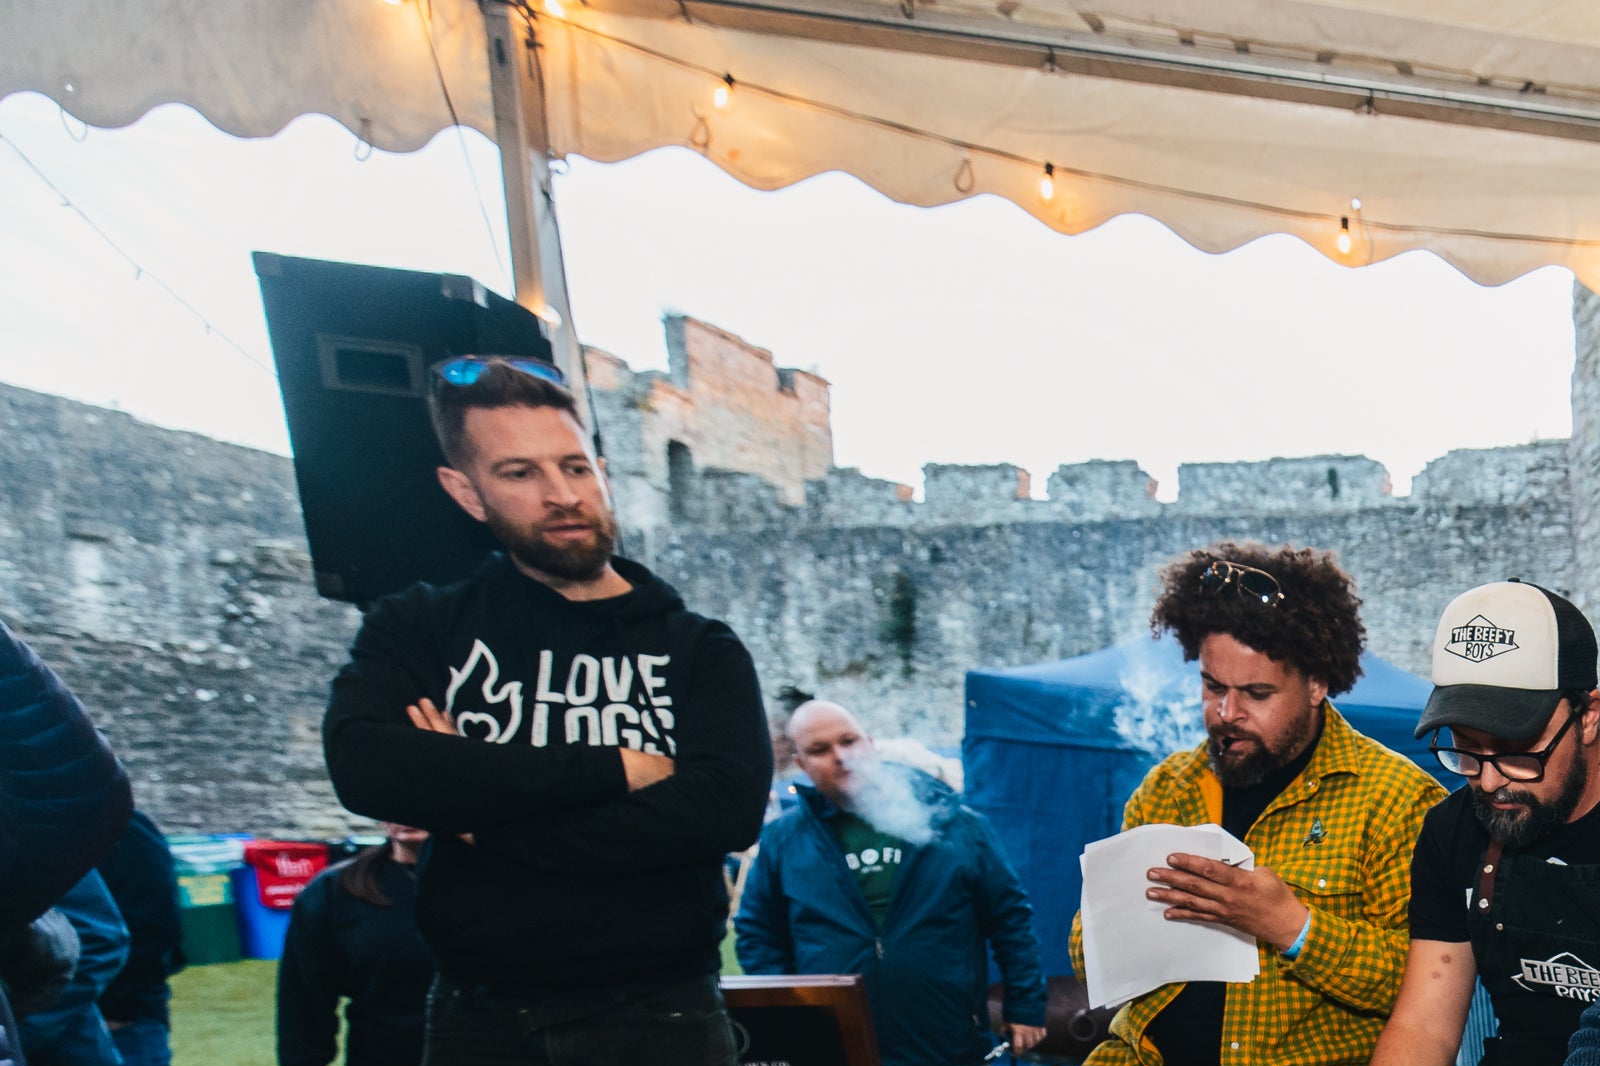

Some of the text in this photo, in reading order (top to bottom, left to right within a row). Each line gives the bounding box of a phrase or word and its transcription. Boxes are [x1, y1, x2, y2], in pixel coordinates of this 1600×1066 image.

[1453, 626, 1514, 644] THE BEEFY
[1465, 642, 1495, 659] BOYS
[535, 649, 673, 706] LOVE
[1524, 962, 1563, 983] THE
